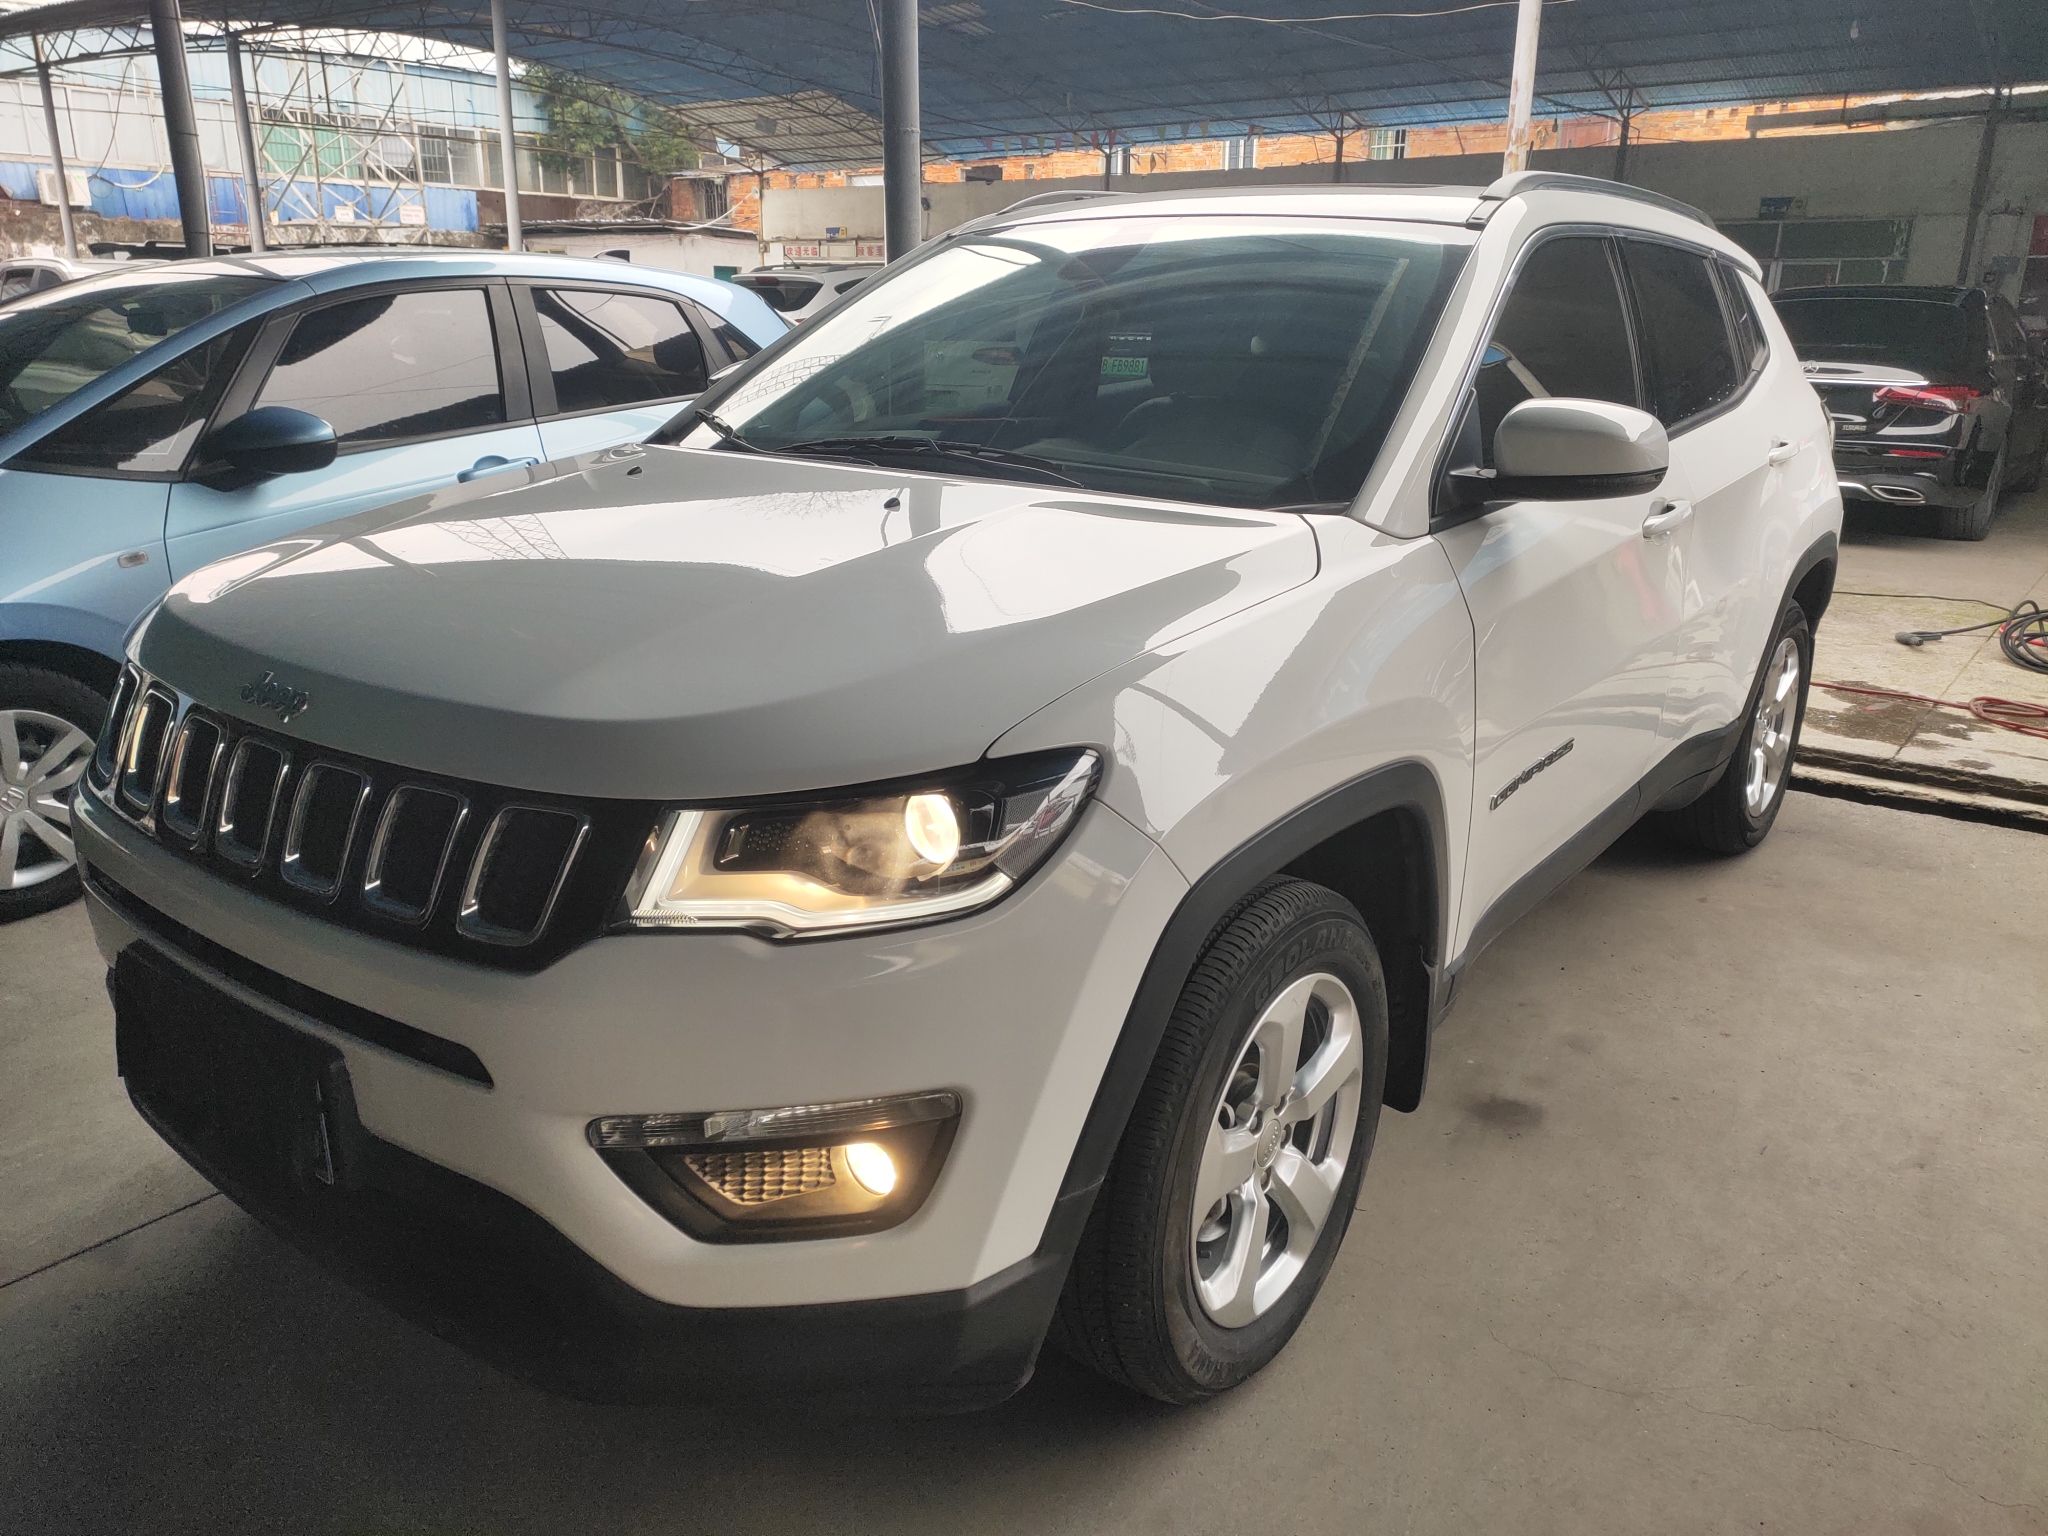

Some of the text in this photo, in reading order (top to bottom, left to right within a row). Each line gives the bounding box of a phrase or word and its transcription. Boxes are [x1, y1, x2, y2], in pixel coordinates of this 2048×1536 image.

[786, 246, 819, 257] 欢迎光临
[239, 670, 309, 724] Jeep
